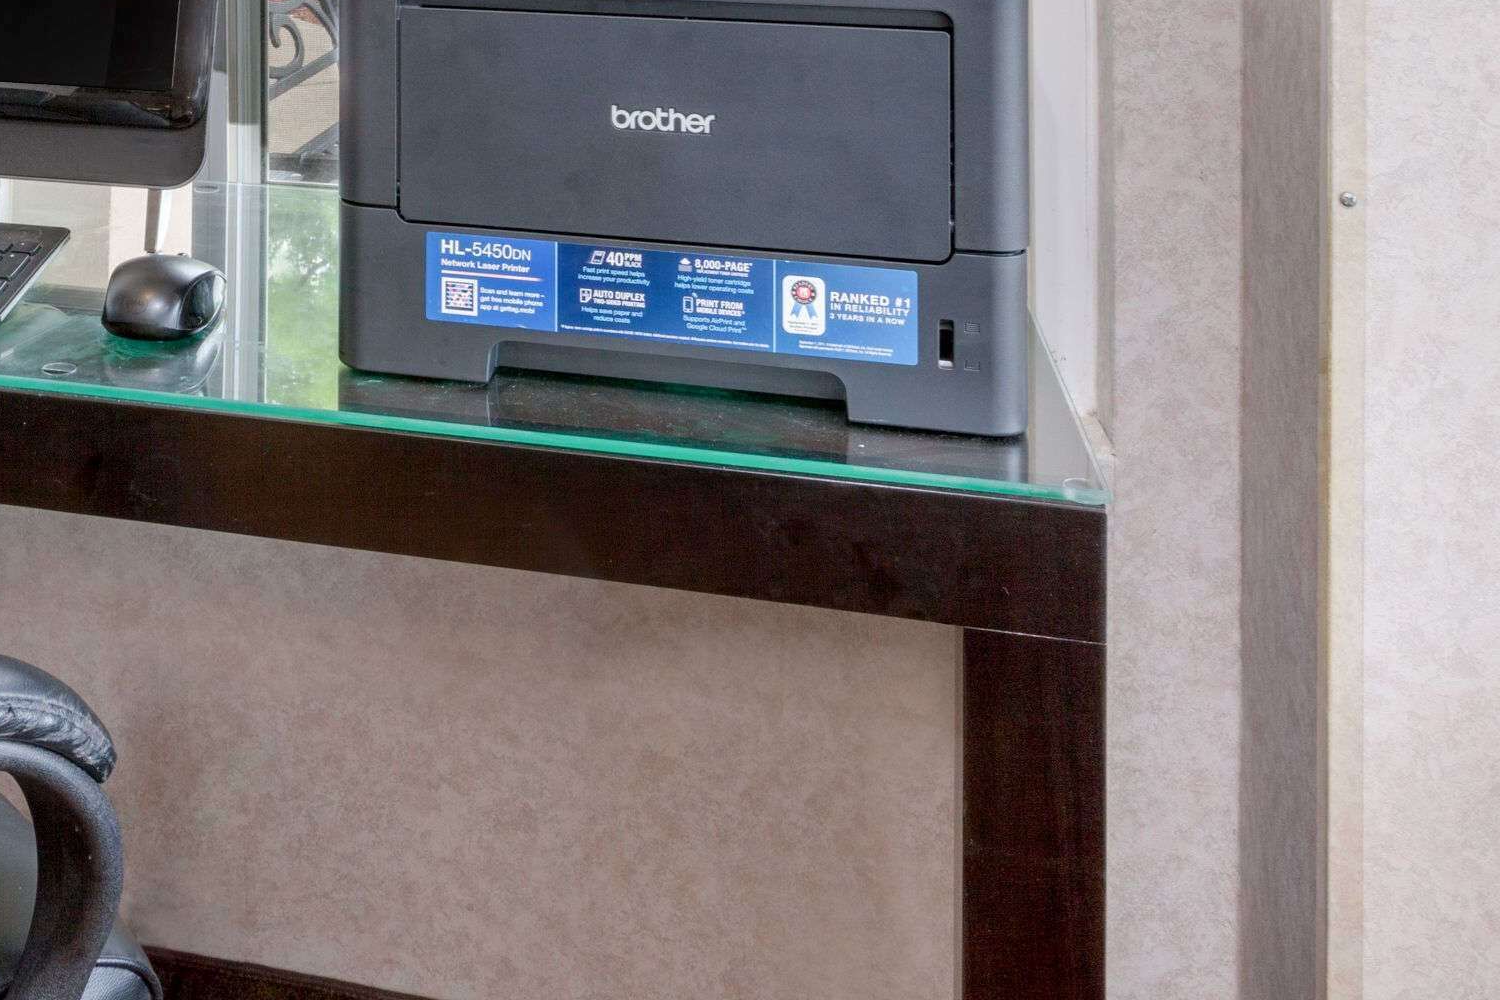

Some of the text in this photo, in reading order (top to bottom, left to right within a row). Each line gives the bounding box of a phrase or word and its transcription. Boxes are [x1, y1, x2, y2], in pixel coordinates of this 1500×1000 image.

[611, 104, 715, 134] brother
[440, 239, 532, 261] HL-5450DN
[605, 251, 624, 266] 40
[624, 253, 642, 262] PPM
[440, 258, 530, 273] Network Laser Printer
[582, 266, 645, 278] Fast print speed helps
[616, 277, 650, 286] productivity
[677, 274, 707, 283] High-yield
[724, 279, 751, 287] cartridge
[496, 288, 508, 296] and
[509, 288, 524, 297] learn
[593, 289, 645, 301] AUTO DUPLEX
[708, 285, 736, 294] operating
[503, 297, 523, 305] mobile
[524, 299, 544, 307] phone
[695, 298, 743, 310] PRINT FROM
[829, 291, 890, 307] RANKED
[894, 296, 911, 309] #1
[613, 309, 630, 317] paper
[829, 302, 910, 317] IN RELIABILITY
[682, 314, 710, 323] Supports
[711, 317, 732, 325] AirPrint
[829, 312, 835, 320] 3
[836, 313, 864, 322] YEARS
[865, 316, 875, 324] IN
[884, 317, 906, 326] ROW
[686, 322, 708, 332] Google
[708, 324, 727, 332] Cloud
